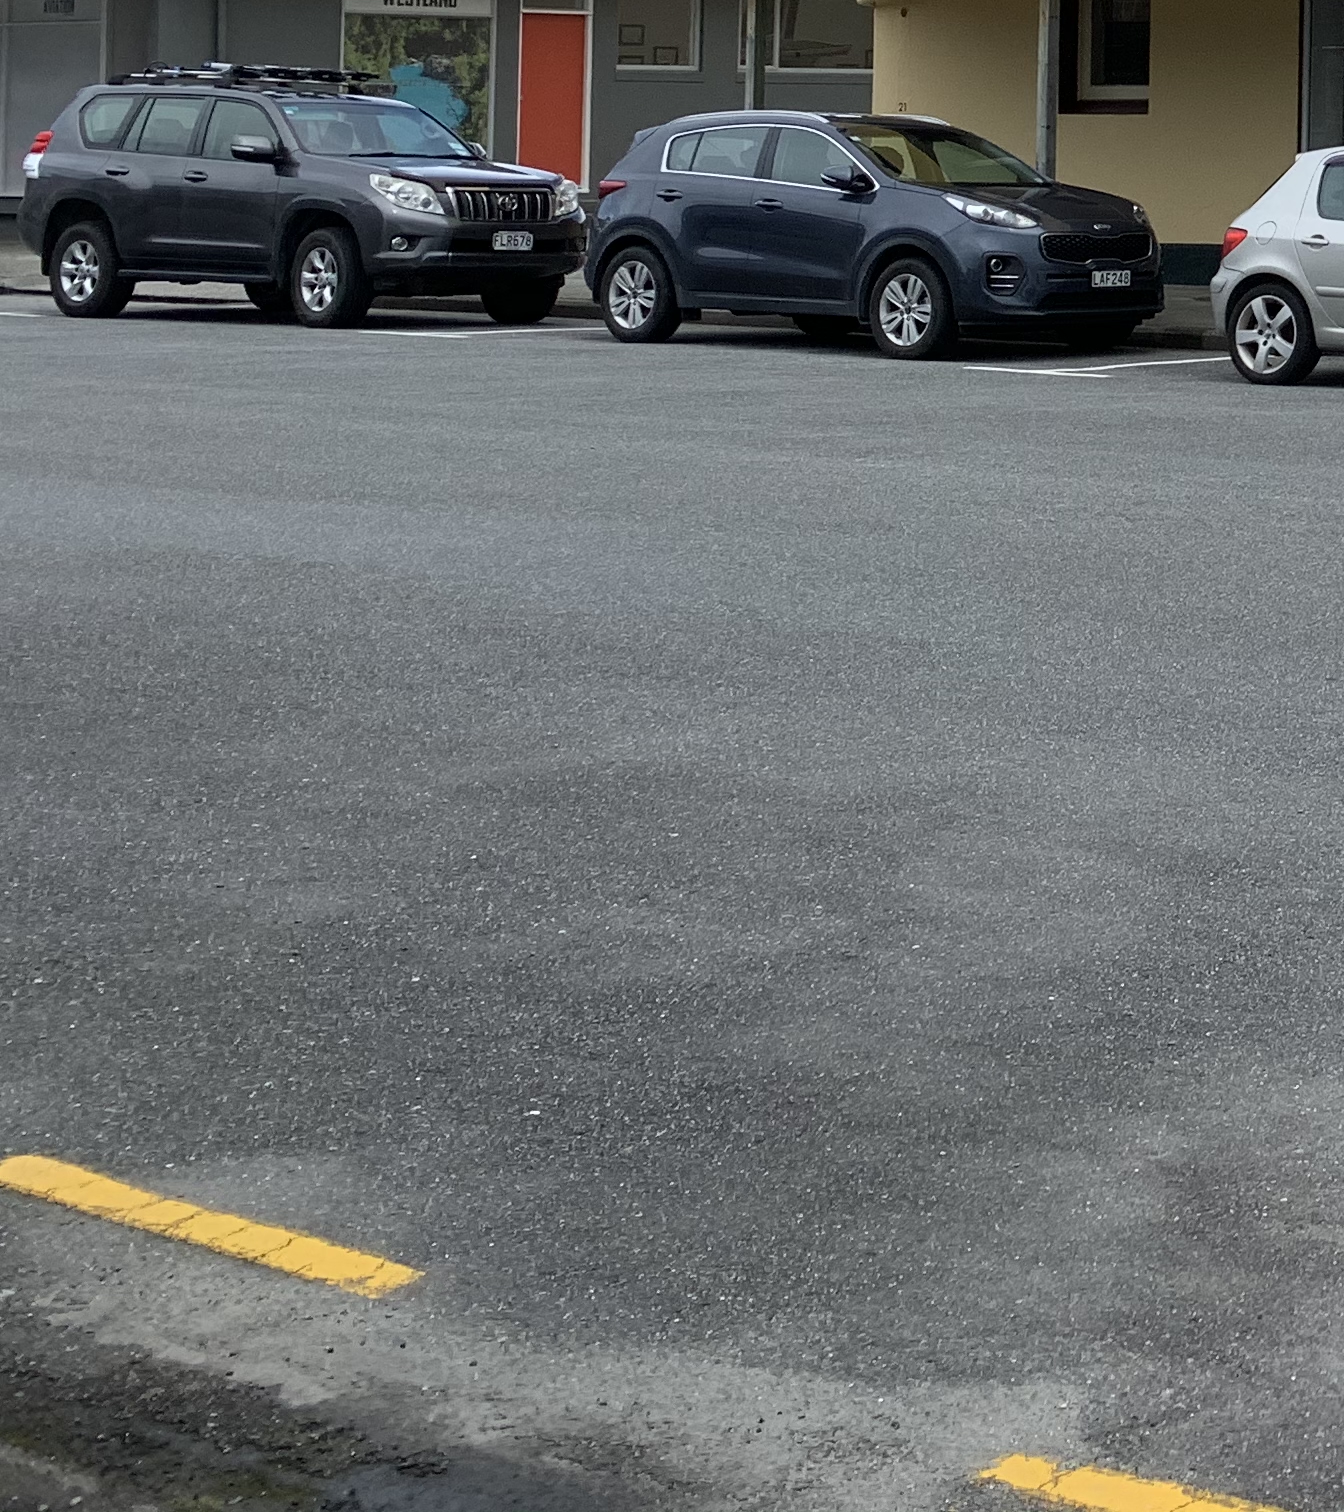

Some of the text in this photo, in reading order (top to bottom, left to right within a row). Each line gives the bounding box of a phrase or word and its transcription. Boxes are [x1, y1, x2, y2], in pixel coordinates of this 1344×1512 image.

[898, 102, 907, 112] 21
[494, 234, 532, 247] FLR678
[1093, 272, 1130, 286] LAF248
